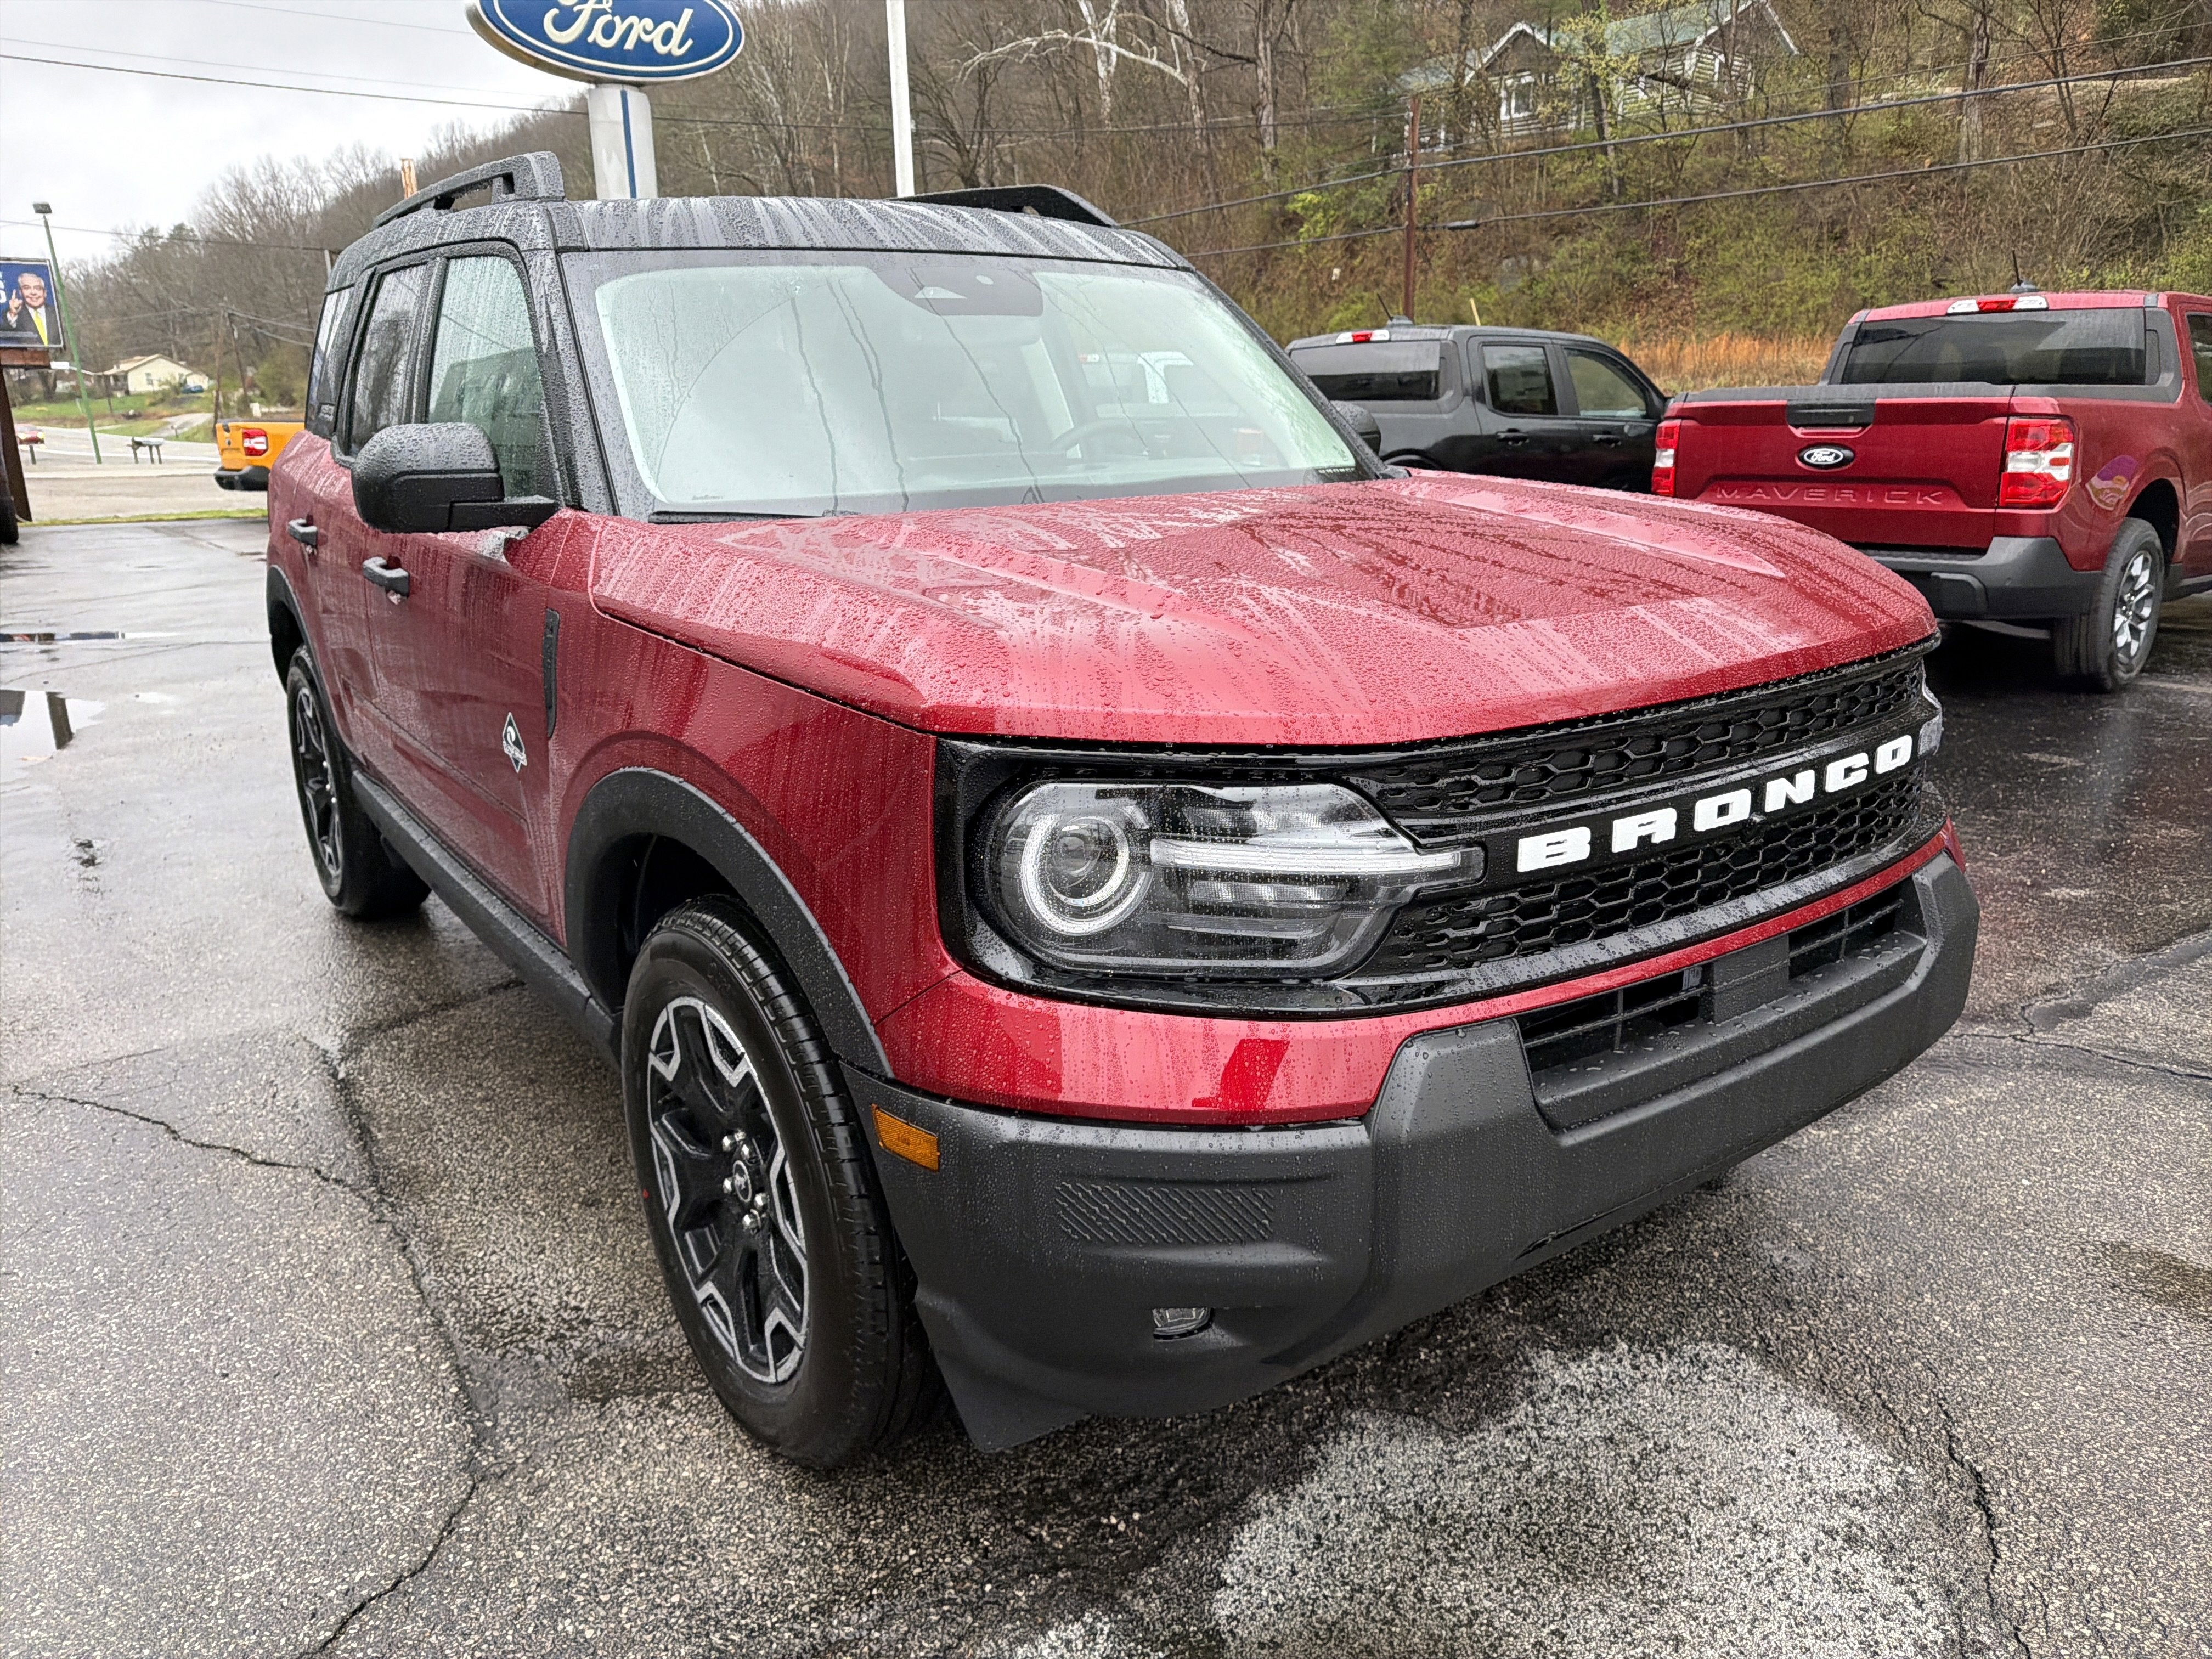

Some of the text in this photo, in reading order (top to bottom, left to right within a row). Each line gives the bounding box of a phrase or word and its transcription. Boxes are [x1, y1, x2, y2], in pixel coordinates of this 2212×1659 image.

[543, 0, 695, 57] Ford
[1810, 449, 1836, 462] Ford
[1716, 486, 1943, 505] MAVERICK
[1517, 734, 1912, 872] BRONCO
